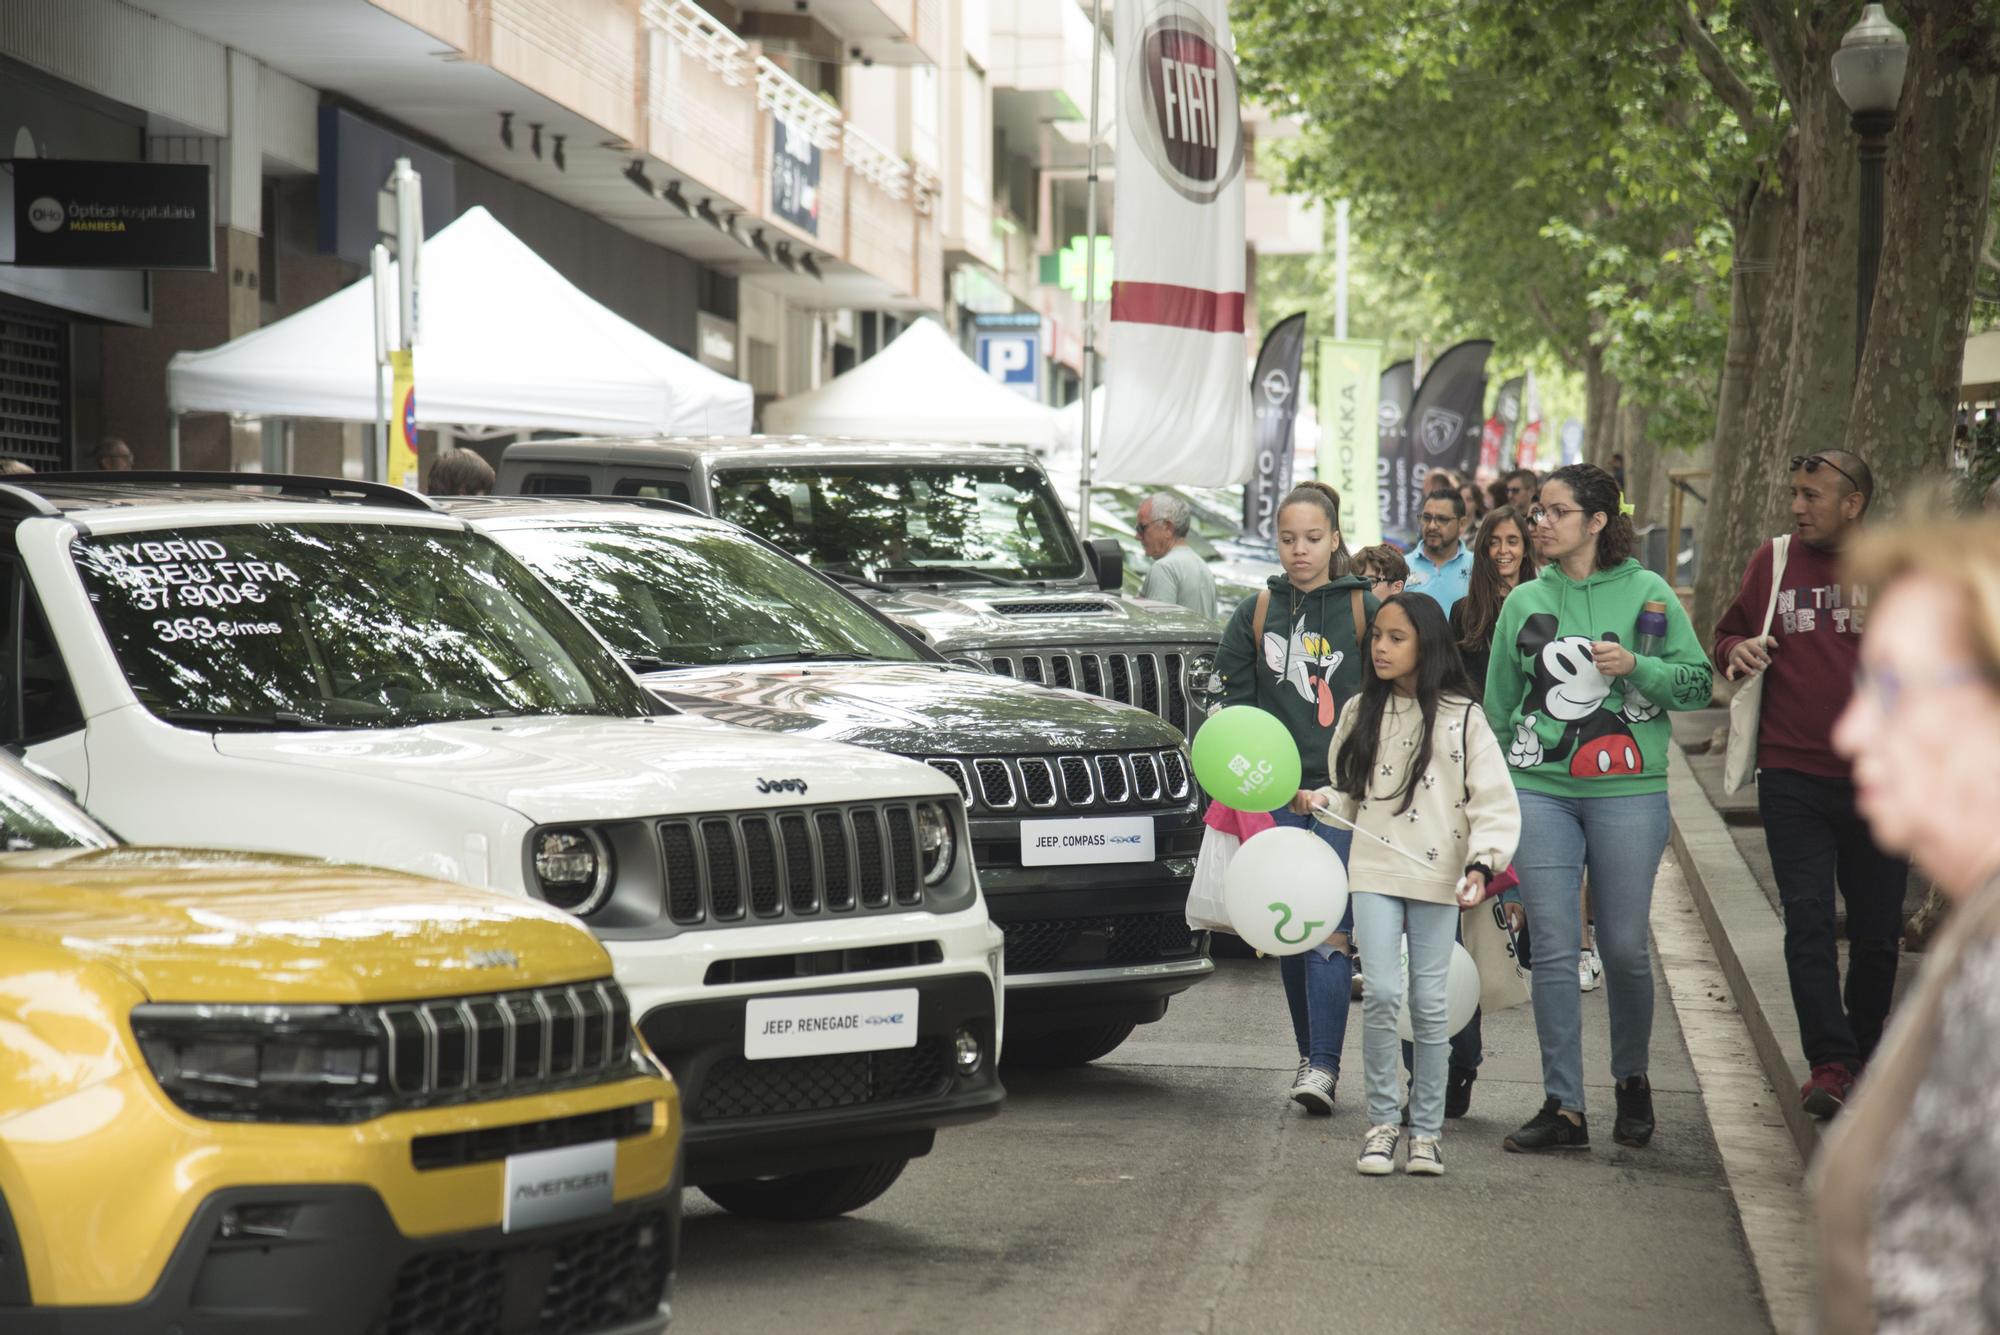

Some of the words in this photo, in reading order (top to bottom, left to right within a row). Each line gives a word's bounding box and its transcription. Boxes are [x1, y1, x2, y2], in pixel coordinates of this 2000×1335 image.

[1161, 57, 1216, 149] FIAT
[1340, 385, 1357, 491] MOKKA
[1258, 450, 1274, 540] AUTO
[101, 540, 227, 563] HYBRID
[214, 562, 299, 583] FIRA
[756, 778, 808, 795] Jeep
[1237, 760, 1273, 796] MGC
[1063, 835, 1105, 846] COMPASS
[798, 1015, 859, 1032] RENEGADE
[516, 1170, 609, 1199] AVENGER
